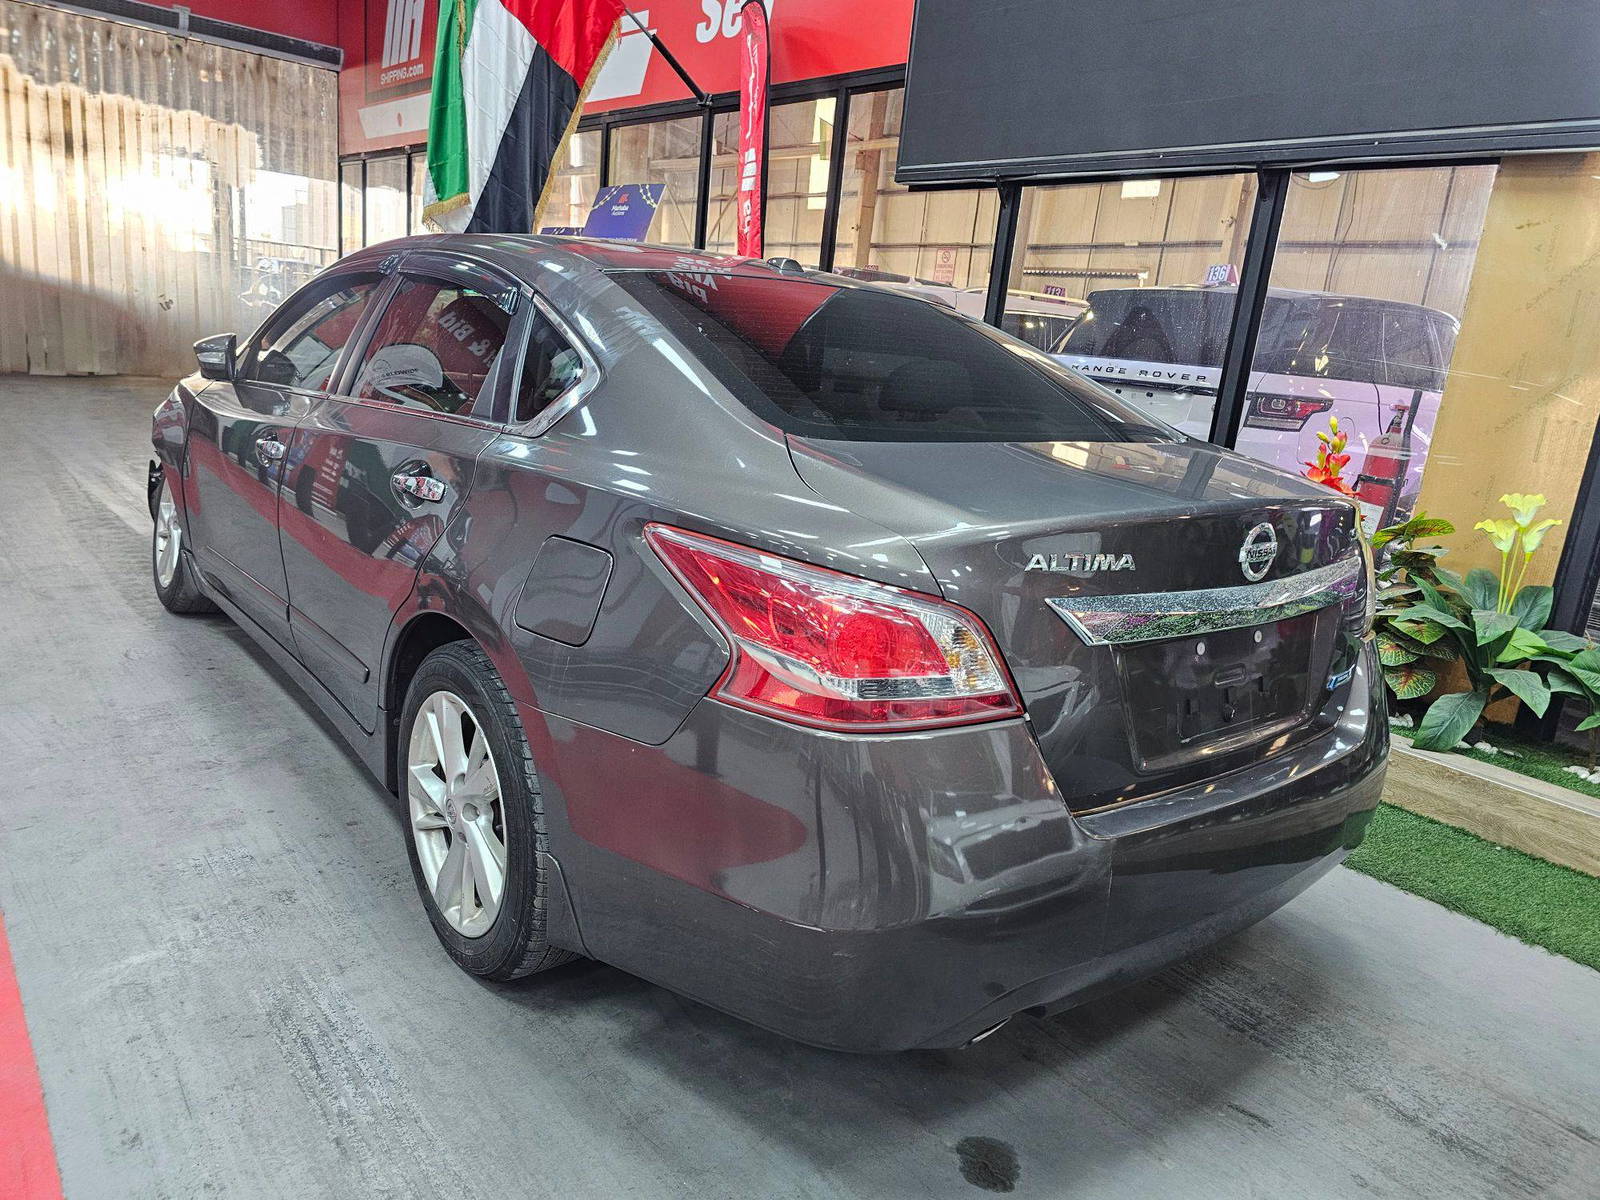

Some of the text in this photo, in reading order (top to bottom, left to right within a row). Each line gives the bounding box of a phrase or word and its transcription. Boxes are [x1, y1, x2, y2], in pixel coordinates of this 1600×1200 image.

[1209, 264, 1226, 281] 136
[1137, 368, 1207, 382] ROVER
[1246, 543, 1277, 559] NISSAN
[1024, 553, 1136, 573] ALTIMA
